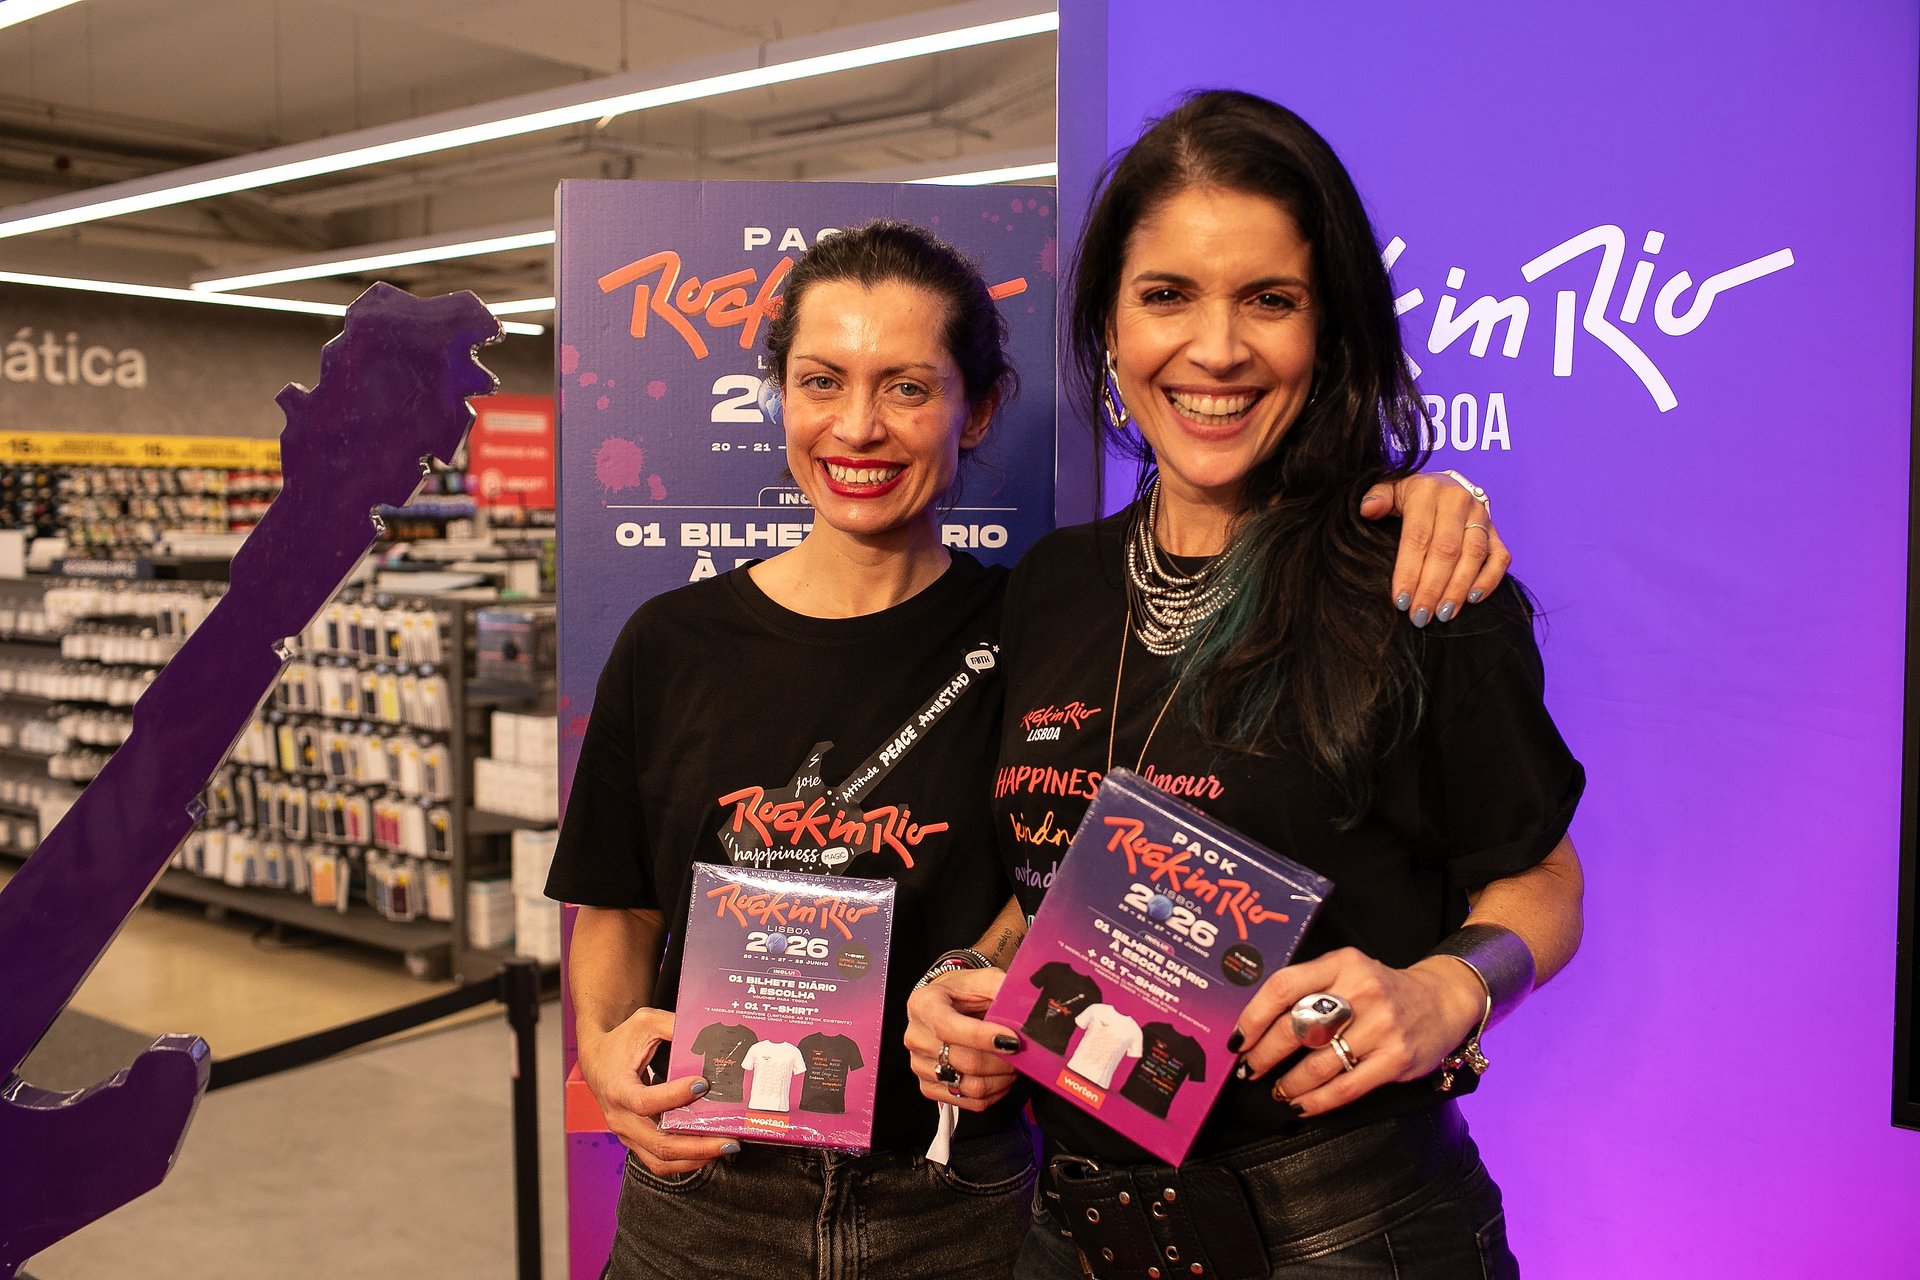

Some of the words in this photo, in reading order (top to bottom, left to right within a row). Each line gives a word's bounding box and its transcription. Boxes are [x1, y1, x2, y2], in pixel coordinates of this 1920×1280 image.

[744, 227, 843, 252] PA
[1427, 266, 1530, 359] in
[1520, 224, 1795, 413] Rio
[0, 326, 147, 389] ática
[1390, 393, 1511, 451] BOA
[711, 442, 731, 452] 20
[753, 442, 771, 452] 21
[779, 492, 811, 505] INC
[615, 522, 666, 547] 01
[680, 523, 814, 547] BILHE
[941, 524, 1008, 548] RIO
[688, 550, 718, 582] À
[1063, 701, 1101, 730] Rio
[842, 765, 880, 803] Attitude
[879, 724, 918, 767] PEACE
[918, 672, 970, 727] AMISTAD
[1026, 726, 1061, 742] LISBOA
[795, 775, 822, 798] joie
[995, 765, 1102, 800] HAPPINES
[718, 786, 831, 848] Rock
[828, 809, 867, 845] in
[862, 805, 949, 869] Rio
[1009, 810, 1076, 846] kindn
[733, 843, 820, 869] happiness
[824, 851, 846, 861] MAGIC
[1171, 831, 1239, 876] PACK
[1103, 816, 1193, 893] Rock
[1183, 867, 1219, 903] in
[1215, 878, 1290, 941] Rio
[706, 883, 789, 928] Rock
[787, 898, 816, 924] in
[814, 896, 878, 940] Rio
[1154, 882, 1203, 915] LISBOA
[1124, 882, 1219, 948] 2026
[767, 924, 811, 935] LISBOA
[746, 931, 829, 959] 2026
[1093, 918, 1110, 934] 01
[1111, 928, 1166, 965] BILHETE
[1165, 958, 1209, 990] DIÁRIO
[1100, 955, 1116, 970] 01
[1121, 946, 1182, 988] ESCOLHA
[728, 974, 743, 984] 01
[746, 976, 795, 988] BILHETE
[798, 980, 837, 992] DIÁRIO
[747, 986, 756, 994] À
[759, 987, 816, 1000] ESCOLHA
[744, 1002, 759, 1011] 01
[1063, 1076, 1099, 1103] worten
[750, 1117, 784, 1128] worten
